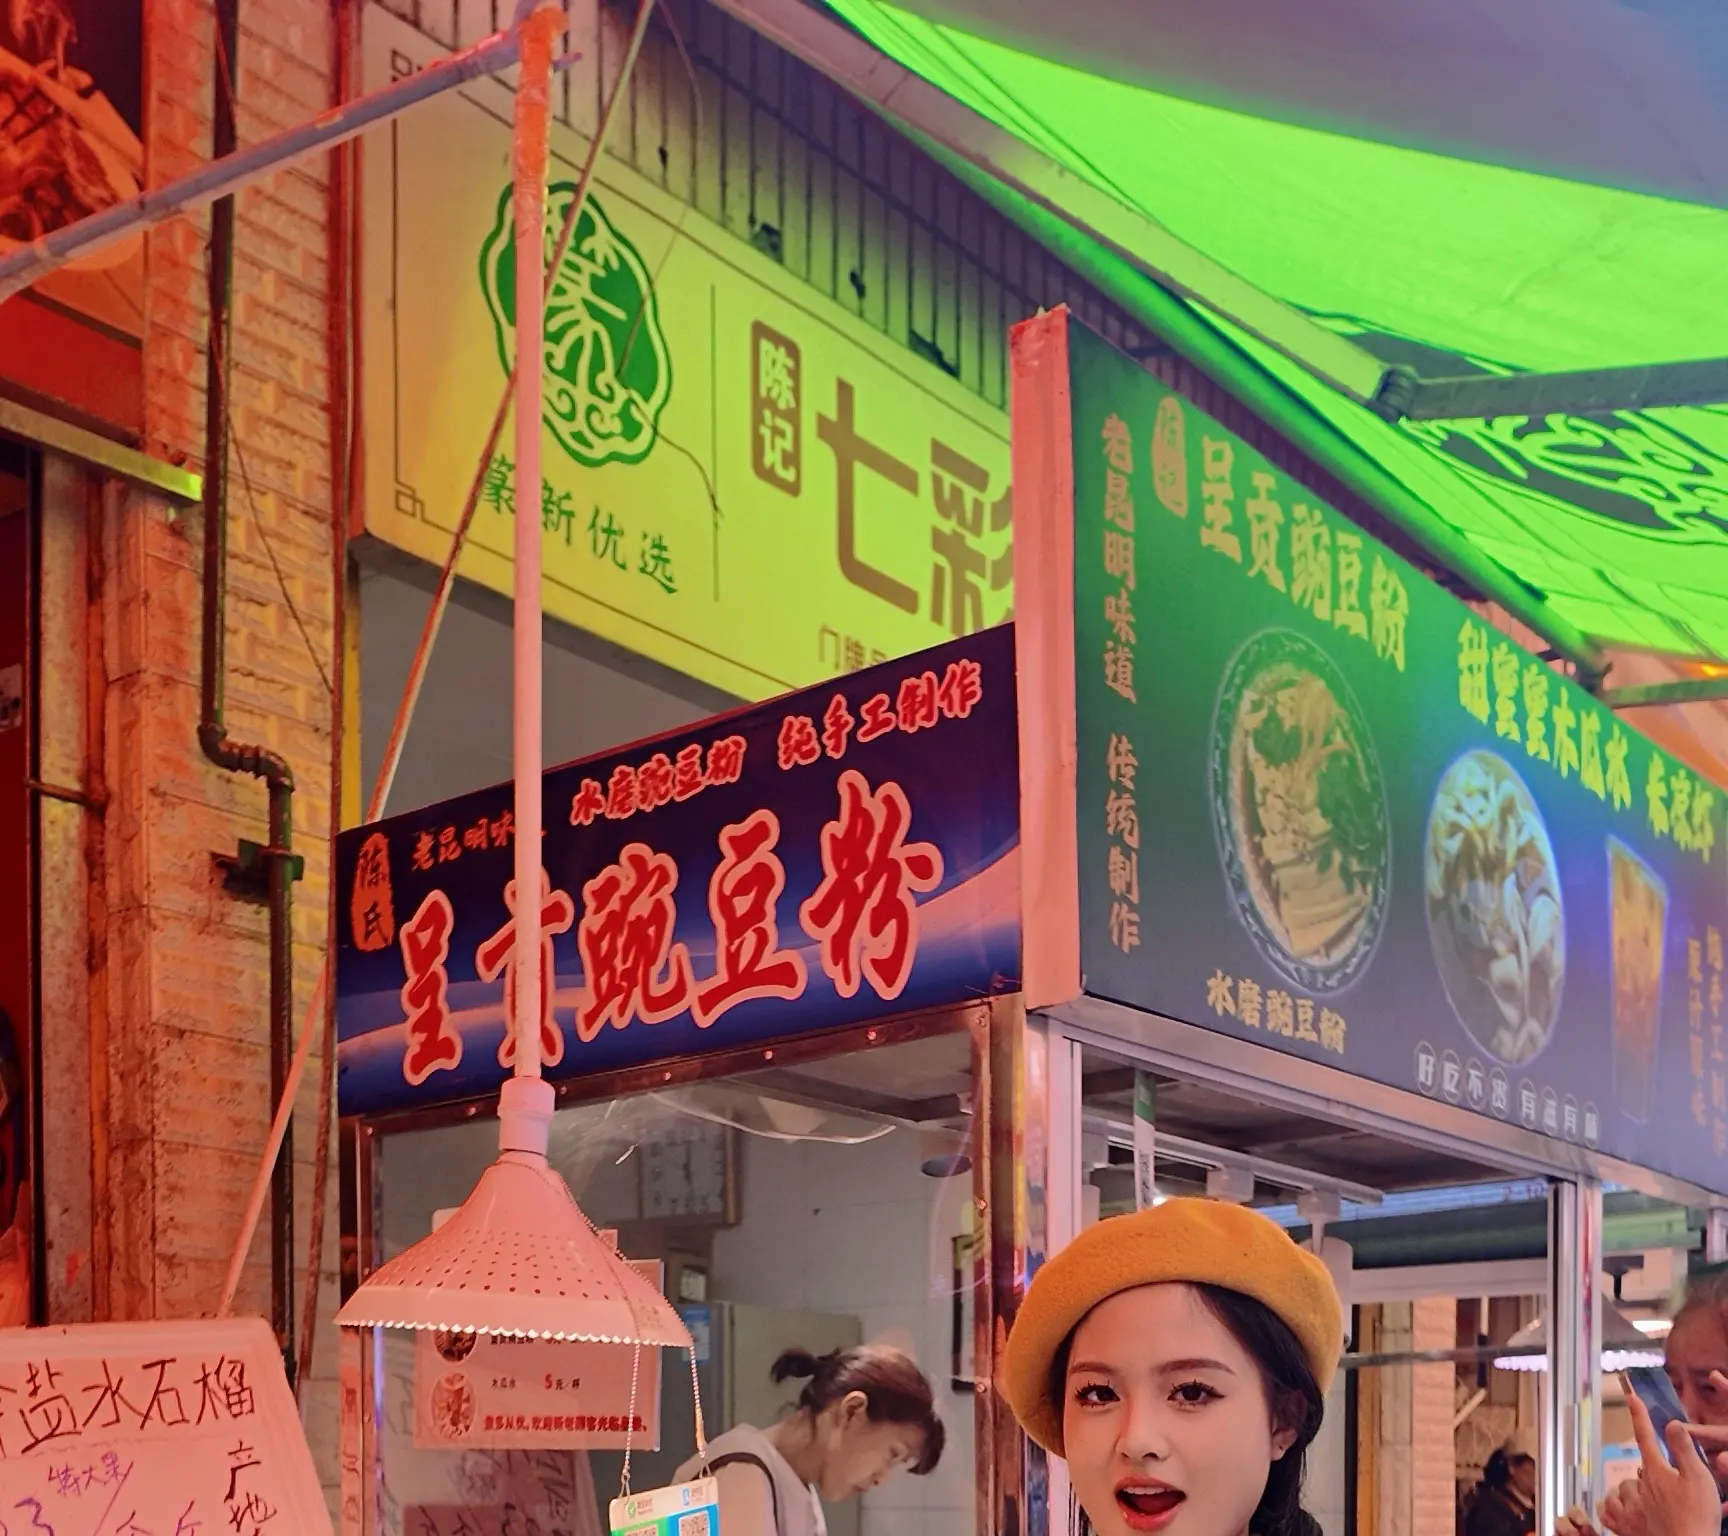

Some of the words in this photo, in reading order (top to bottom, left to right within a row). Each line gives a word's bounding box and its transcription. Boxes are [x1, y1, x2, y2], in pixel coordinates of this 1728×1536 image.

[758, 337, 799, 485] 陈记
[1200, 434, 1409, 673] 呈贡豌豆粉
[569, 735, 747, 826] 水磨豌豆粉
[776, 659, 982, 770] 纯手工制作
[1457, 618, 1632, 813] 甜蜜蜜木瓜水
[411, 808, 547, 872] 老昆明味
[1105, 732, 1141, 953] 传统制作
[1206, 968, 1347, 1056] 水磨豌豆粉
[0, 1356, 255, 1456] 盐水石榴
